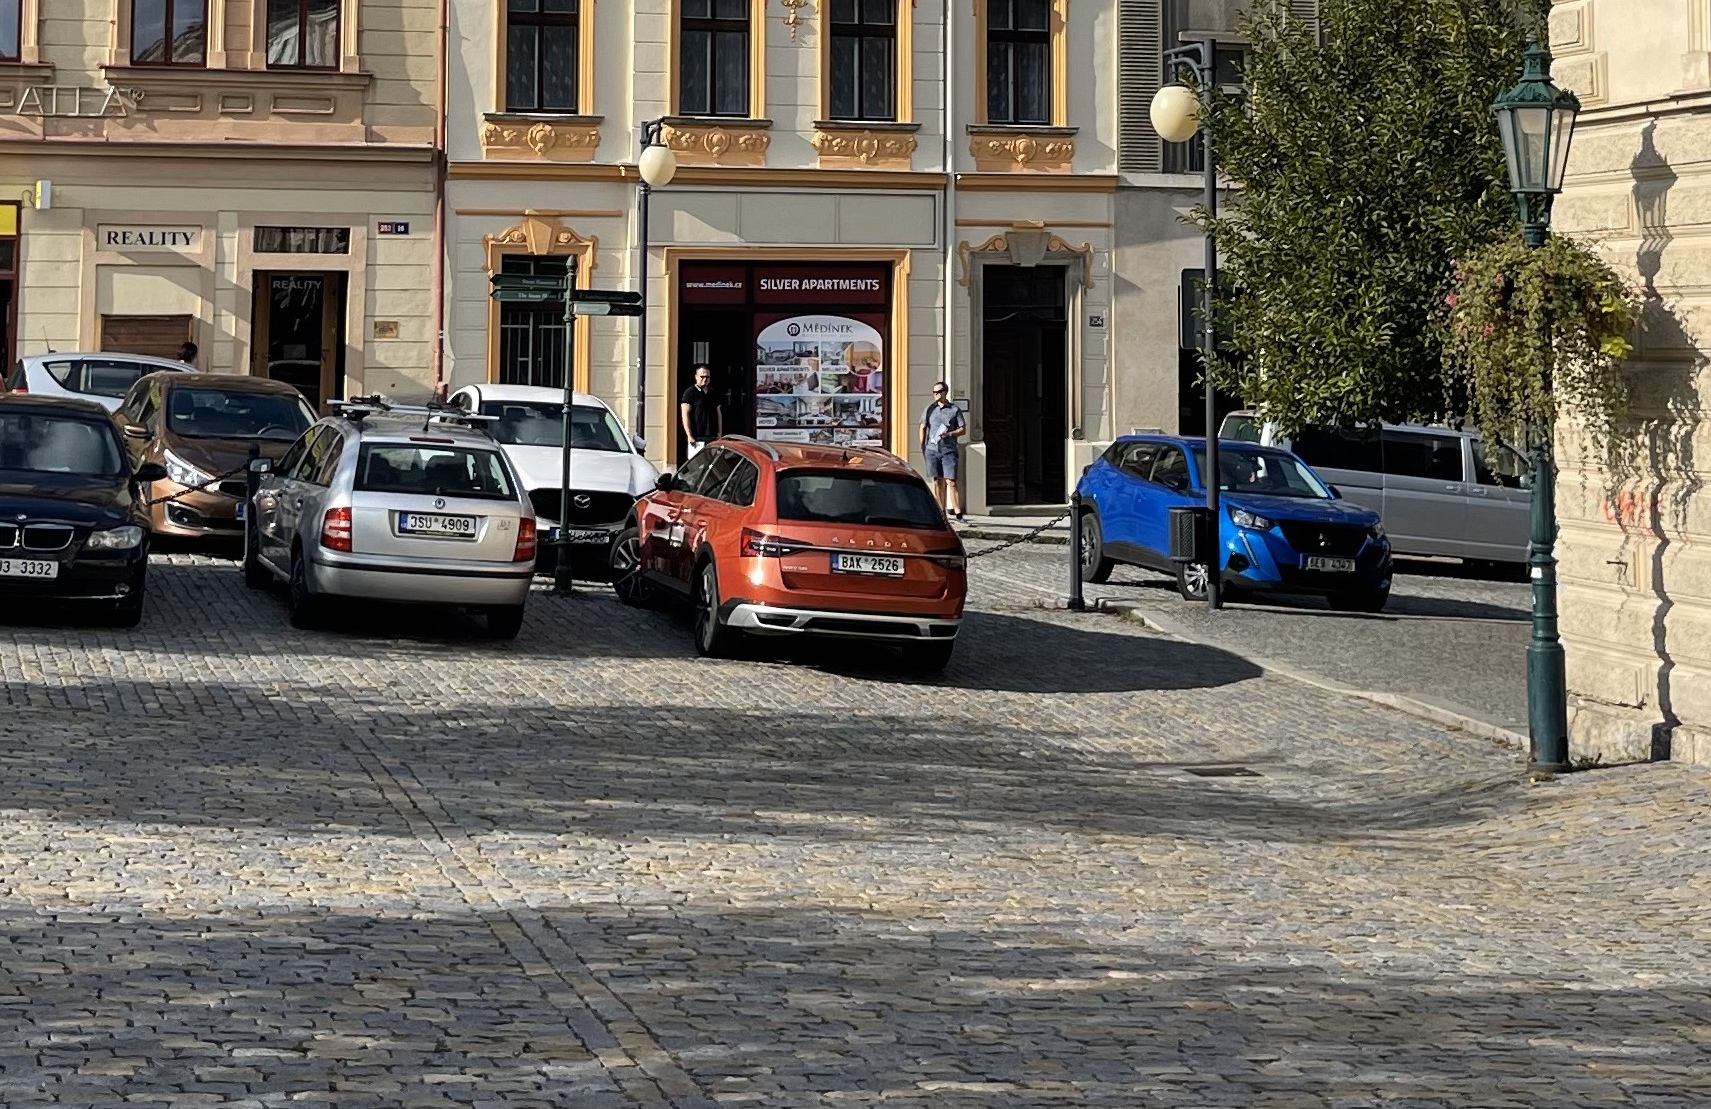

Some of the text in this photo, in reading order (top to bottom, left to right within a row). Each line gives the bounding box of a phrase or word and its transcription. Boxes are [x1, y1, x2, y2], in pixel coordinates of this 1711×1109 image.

[106, 230, 196, 246] REALITY
[272, 280, 322, 289] REALITY
[760, 278, 880, 291] SILVER APARTMENTS
[441, 517, 470, 532] 4909
[20, 561, 52, 576] 3332
[871, 557, 899, 572] 2526
